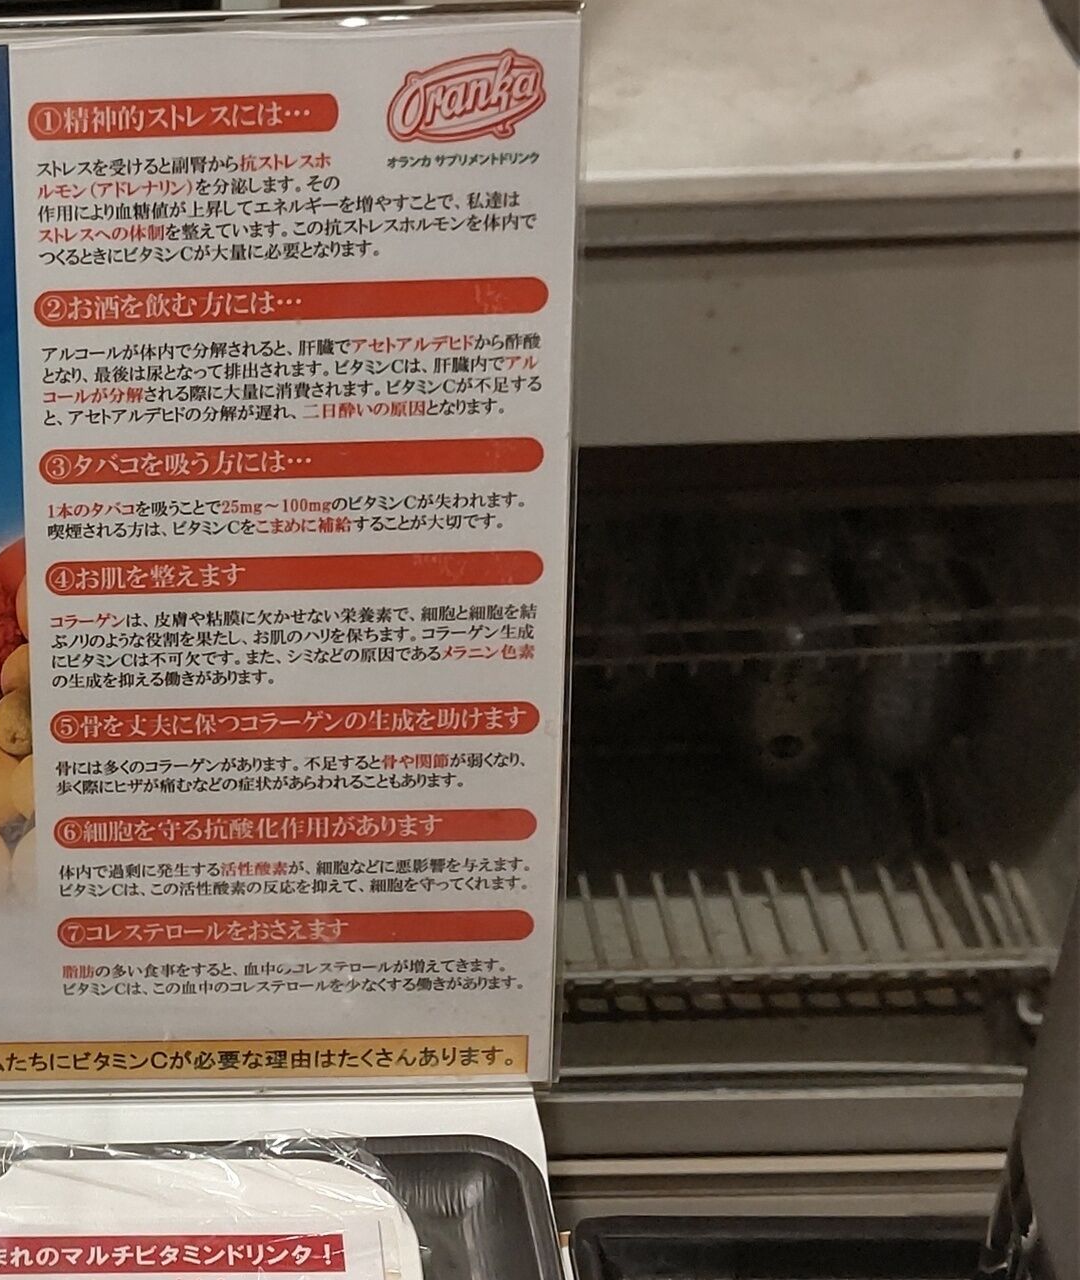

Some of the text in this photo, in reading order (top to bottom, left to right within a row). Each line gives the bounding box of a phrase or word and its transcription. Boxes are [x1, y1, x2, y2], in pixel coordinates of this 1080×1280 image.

[390, 53, 544, 141] Oranka
[36, 153, 332, 178] ストレスを受けると副腎から抗ストレスホ
[386, 151, 541, 169] オランカ サプリメントドリンク
[37, 174, 340, 199] ルモン（アドレナリン）を分泌します。その
[38, 239, 380, 266] つくるときにビタミンCが大量に必要となります。
[47, 512, 504, 539] 喫煙される方は、ビタミンCをこまめに補給することが大切です。
[48, 564, 246, 591] ④お肌を整えます
[52, 670, 275, 689] の生成を抑える働きがあります。
[52, 706, 527, 743] ⑤骨を丈夫に保つコラーゲンの生成を助けます
[58, 814, 443, 844] ⑥細胞を守る抗酸化作用があります
[60, 918, 350, 943] ⑦コレステロールをおさえます
